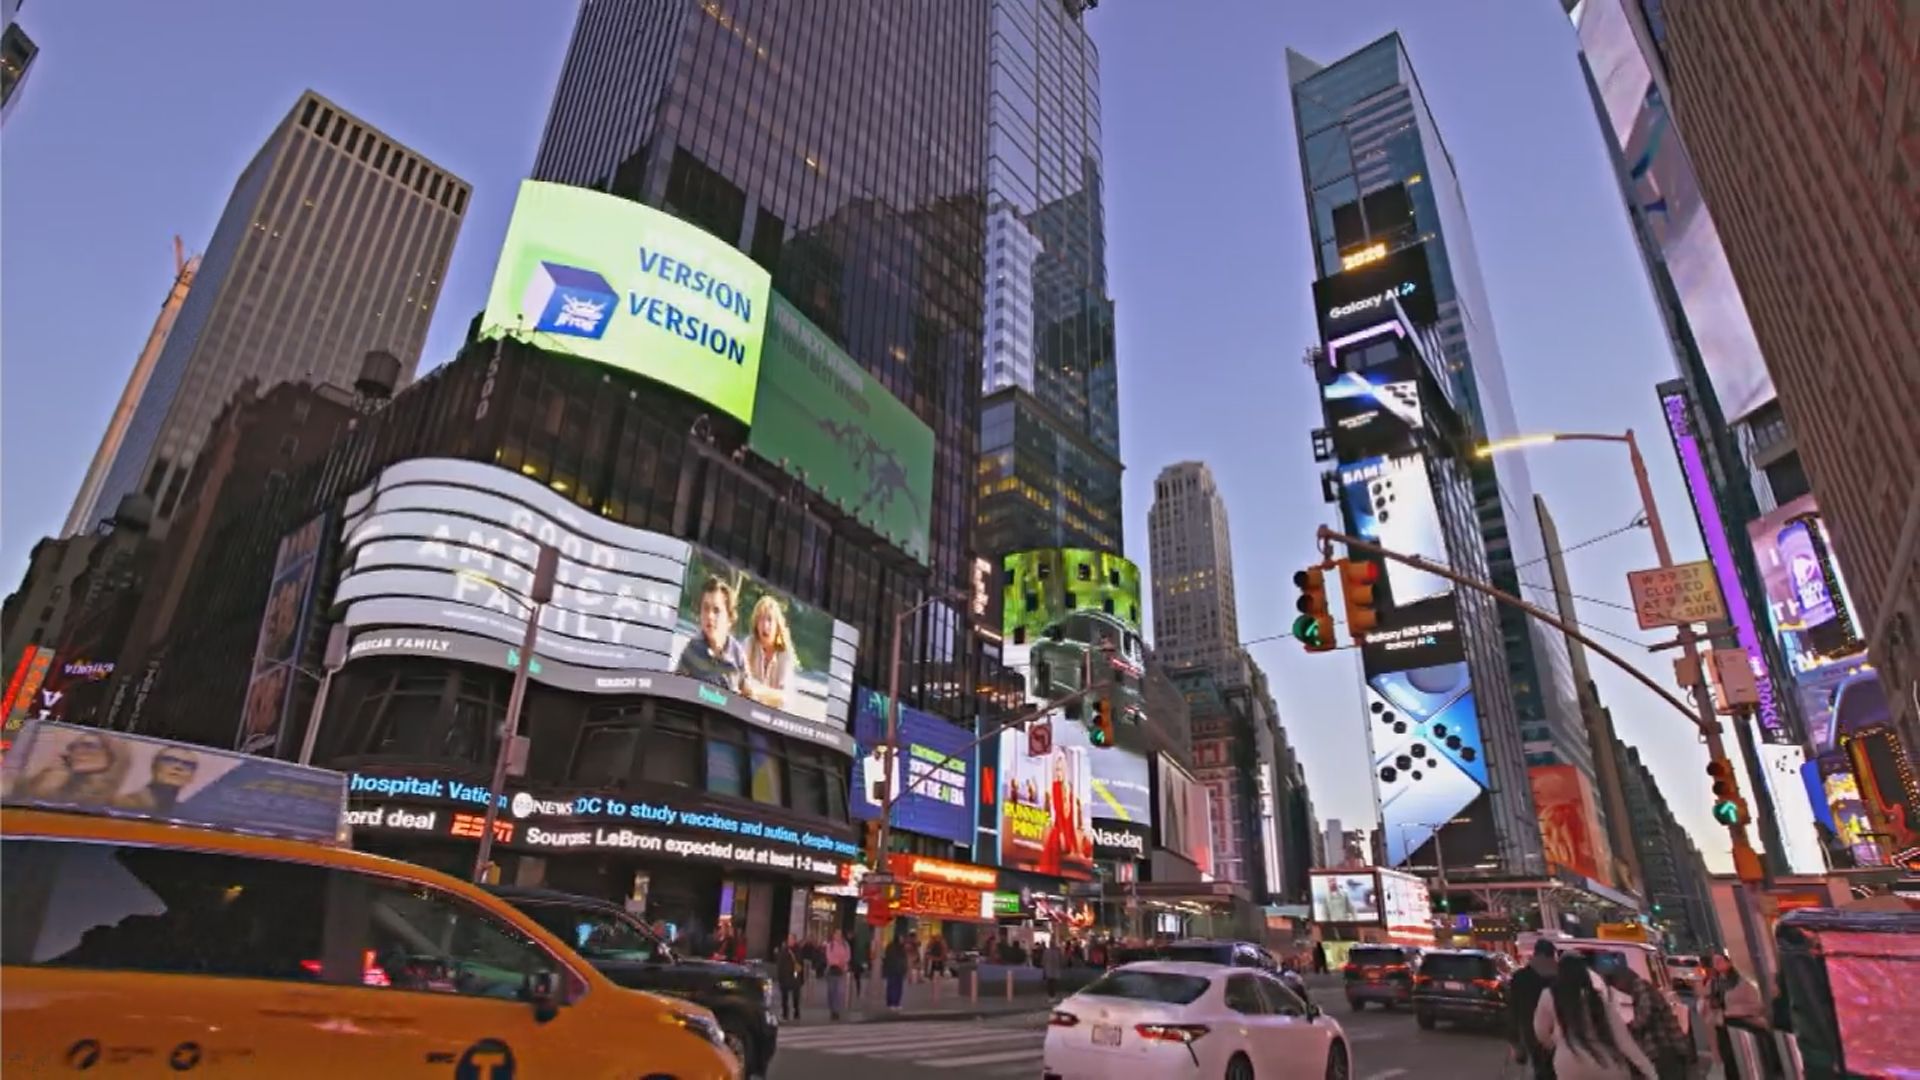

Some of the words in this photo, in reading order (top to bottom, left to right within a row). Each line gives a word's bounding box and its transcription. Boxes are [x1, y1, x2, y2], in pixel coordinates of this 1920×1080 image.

[639, 247, 752, 323] VERSION
[1330, 294, 1382, 318] Galaxy
[628, 292, 746, 366] VERSION
[416, 525, 674, 620] AMEICAN
[1645, 580, 1704, 597] CLOSED
[1683, 590, 1713, 604] AVE
[396, 638, 451, 651] FAMILY
[350, 773, 443, 797] hospital:
[448, 781, 508, 809] Vaticn
[387, 810, 436, 830] deal
[606, 800, 626, 815] to
[630, 803, 677, 825] study
[680, 811, 738, 833] vaccines
[740, 821, 763, 837] and
[595, 829, 661, 851] LeBron
[665, 837, 733, 858] expected
[734, 848, 756, 863] out
[1091, 828, 1143, 854] Nasdaq
